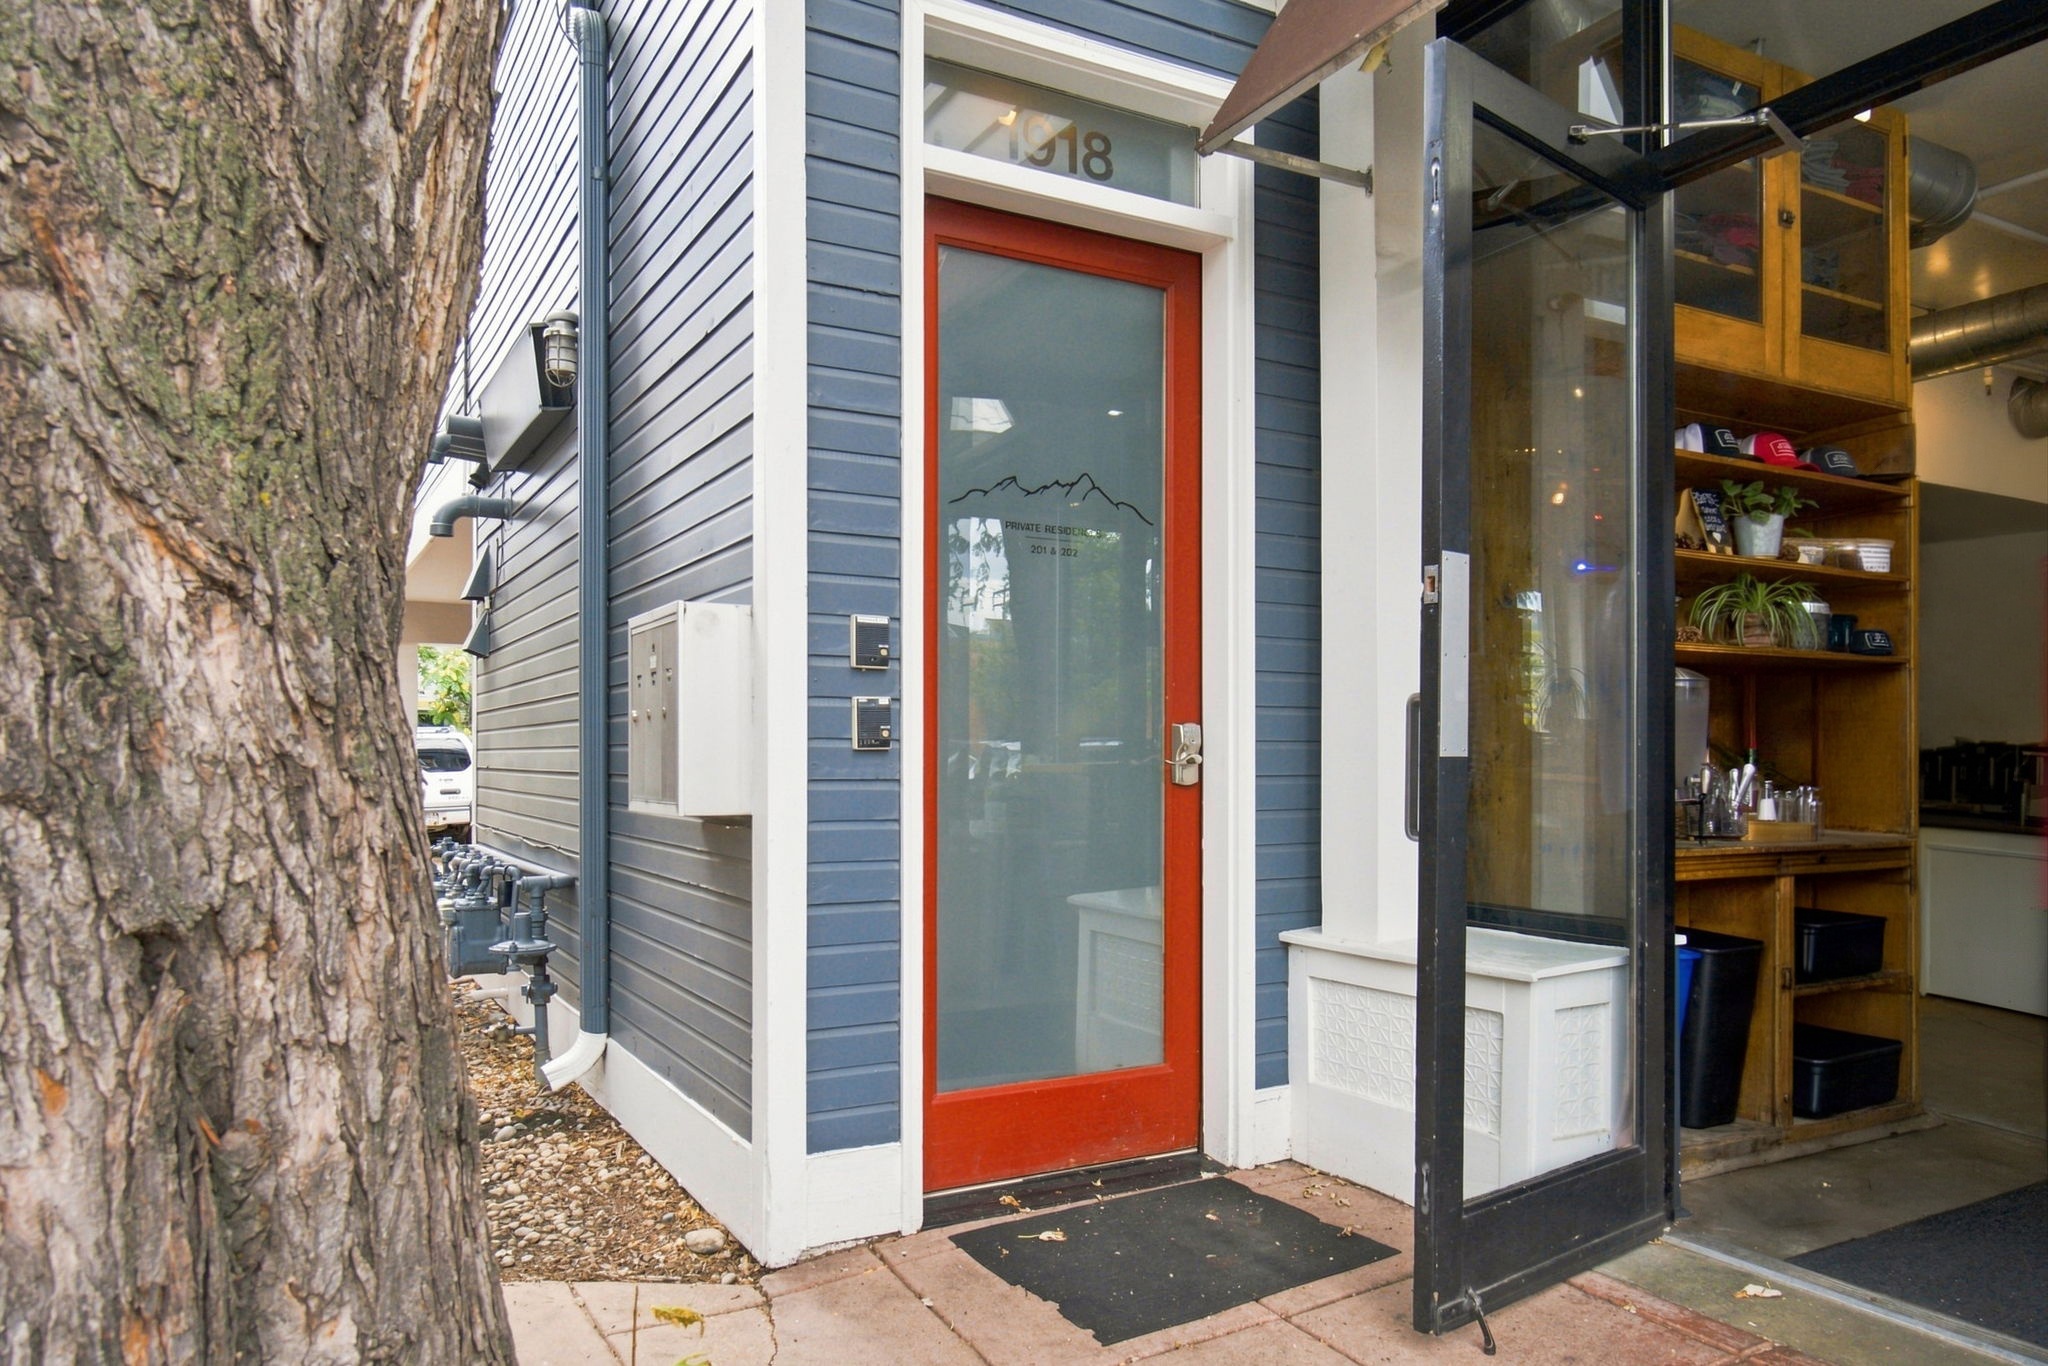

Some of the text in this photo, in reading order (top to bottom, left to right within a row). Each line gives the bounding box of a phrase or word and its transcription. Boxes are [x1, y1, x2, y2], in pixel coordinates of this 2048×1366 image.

[1007, 108, 1114, 181] 1918
[1005, 520, 1102, 539] PRIVATE RESIDENCS
[1030, 544, 1079, 557] 201 & 202
